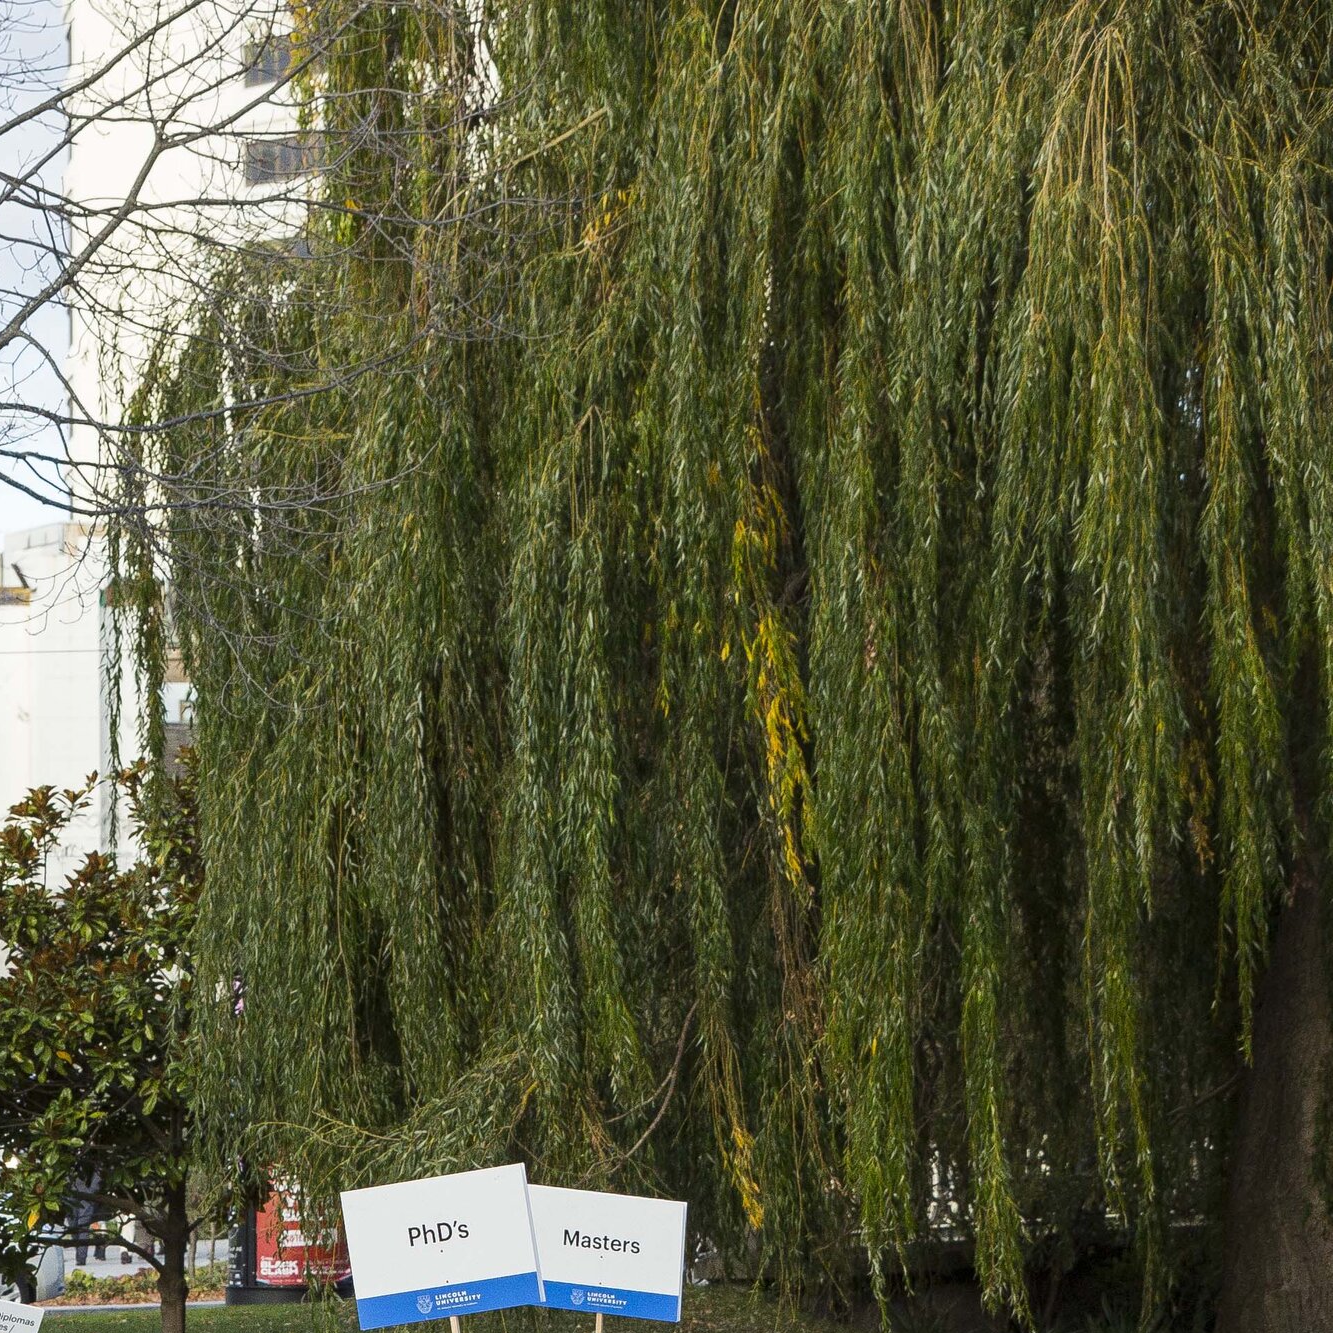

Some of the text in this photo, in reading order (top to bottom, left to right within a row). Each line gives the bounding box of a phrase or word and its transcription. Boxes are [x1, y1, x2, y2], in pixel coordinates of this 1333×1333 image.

[408, 1220, 470, 1246] PhD's
[563, 1229, 640, 1254] Masters
[435, 1291, 467, 1300] LINCOLN
[435, 1294, 481, 1306] UNIVERSITY
[587, 1297, 627, 1305] UNIVERSITY
